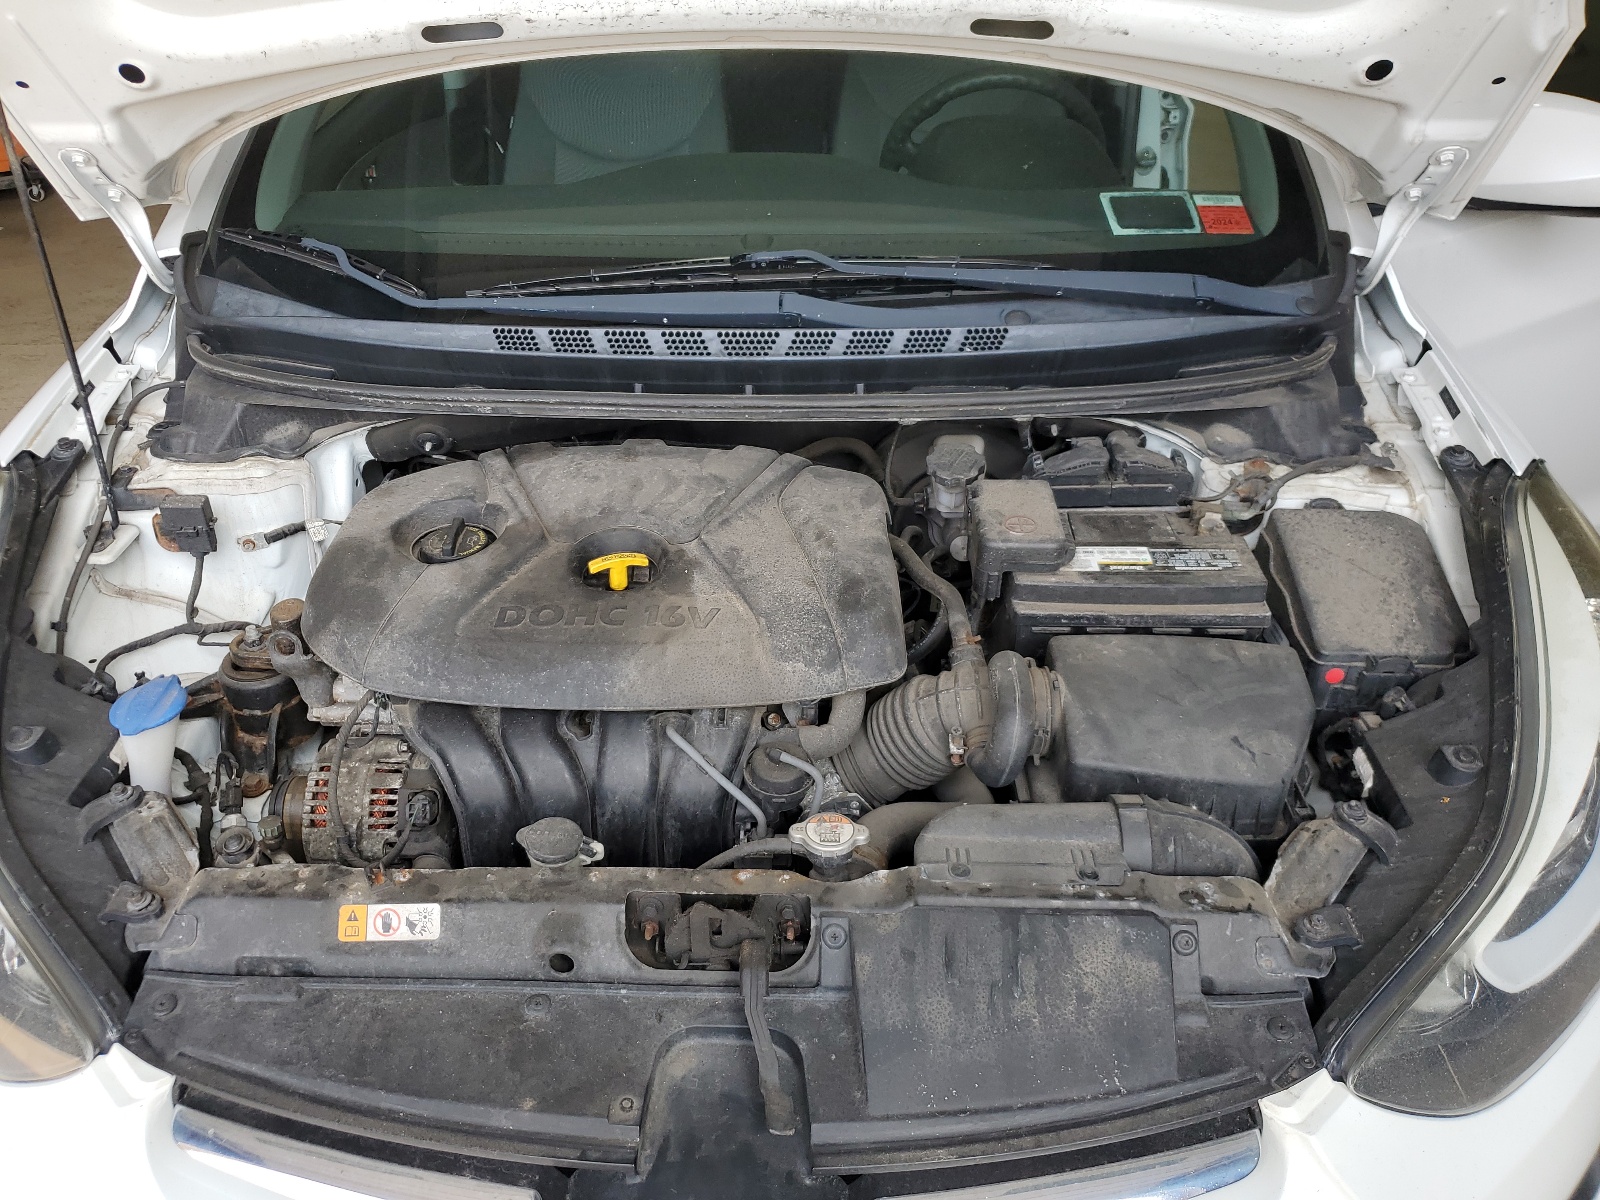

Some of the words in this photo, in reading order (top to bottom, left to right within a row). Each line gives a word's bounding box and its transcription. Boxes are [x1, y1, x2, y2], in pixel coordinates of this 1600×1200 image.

[1211, 218, 1233, 226] 2024
[494, 604, 628, 628] DOHC
[645, 604, 722, 629] 16V
